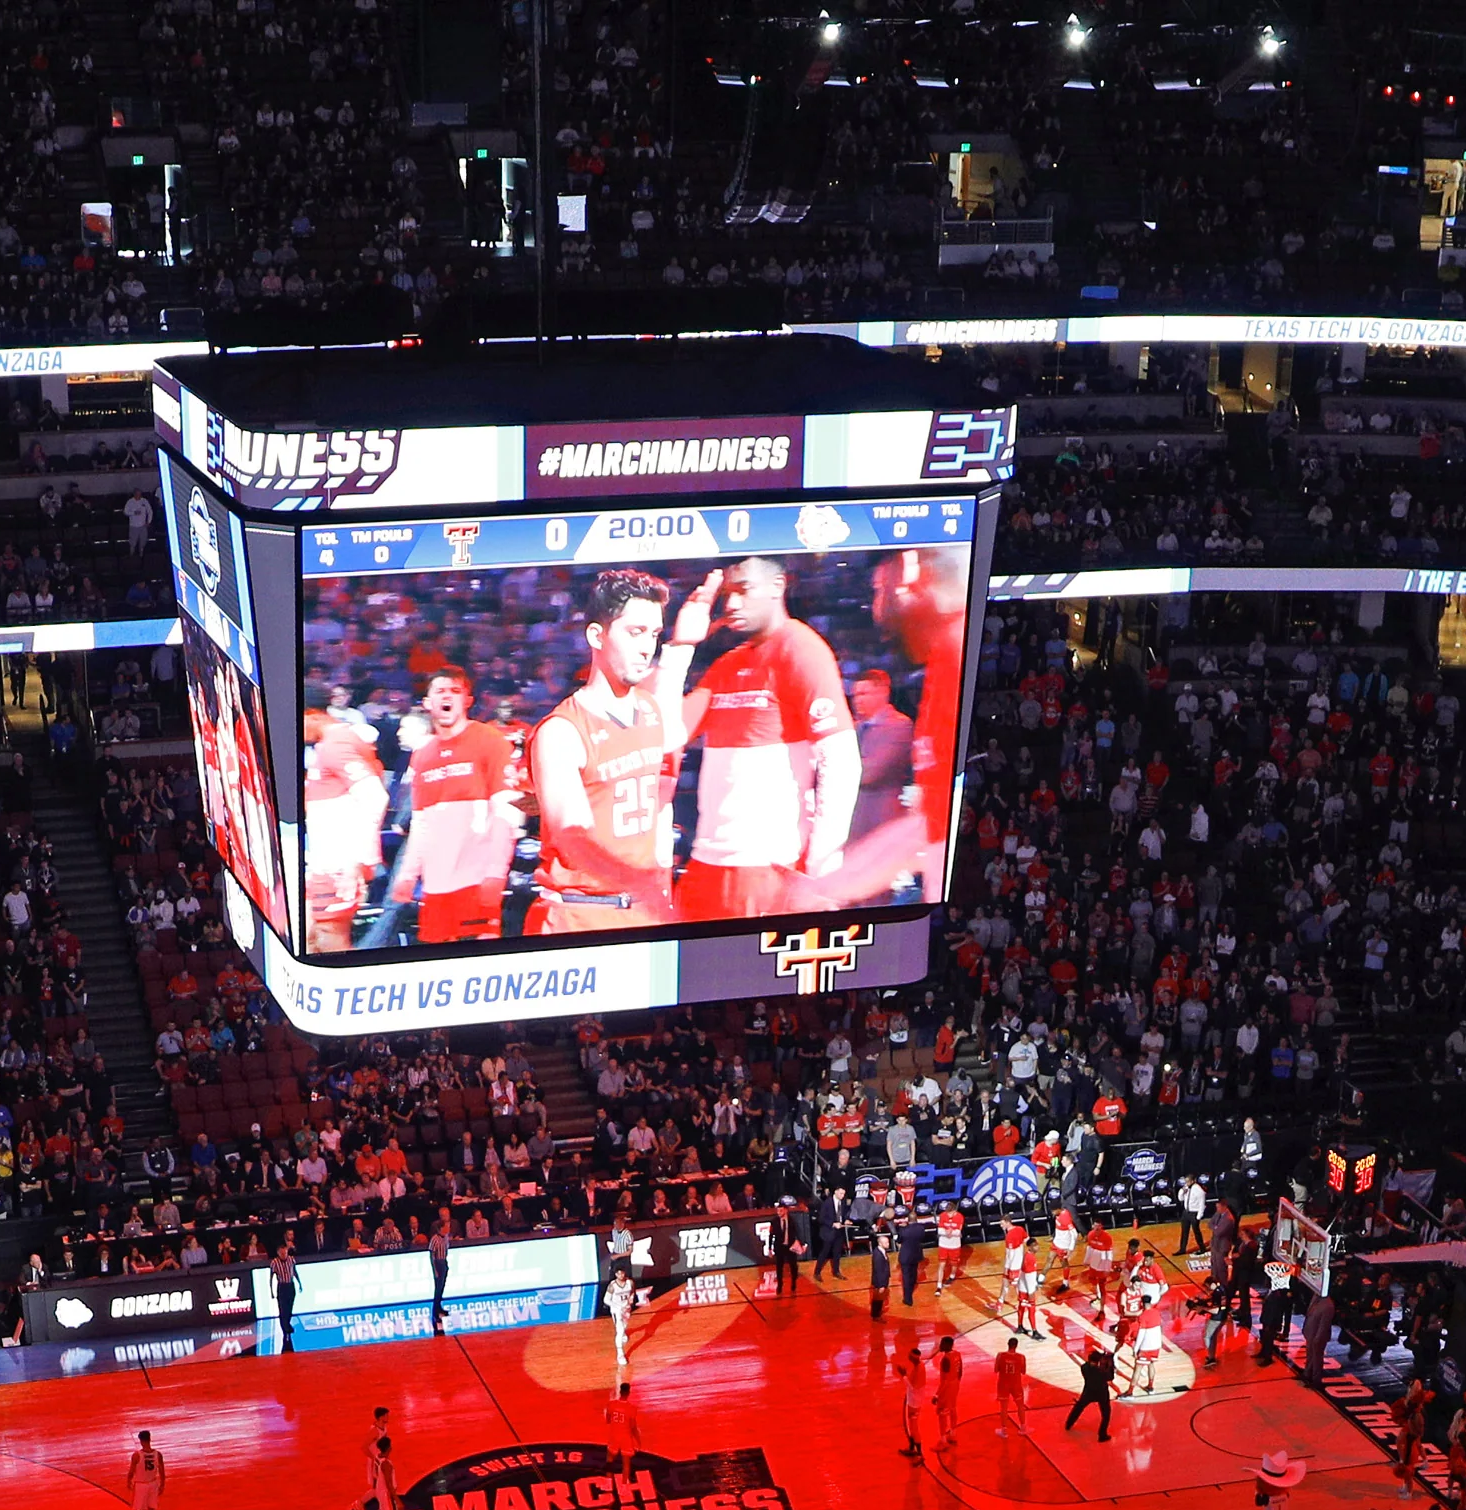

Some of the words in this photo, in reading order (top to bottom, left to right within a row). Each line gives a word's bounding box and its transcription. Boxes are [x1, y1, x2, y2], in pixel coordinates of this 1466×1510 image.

[905, 319, 1057, 345] #MARCHMADNESS
[1244, 320, 1300, 339] TEXAS
[1308, 321, 1352, 339] TECH
[1358, 321, 1382, 340] VS
[538, 436, 791, 478] #MARCHMADNESS
[872, 507, 891, 519] TM
[351, 530, 372, 543] TM
[373, 528, 413, 542] FOULS
[546, 518, 568, 551] 0
[608, 514, 694, 539] 20:00
[728, 511, 750, 542] 0
[1417, 570, 1455, 593] THE
[612, 772, 658, 838] 25
[334, 982, 407, 1016] TECH
[417, 979, 452, 1009] VS
[463, 966, 598, 1005] GONZAGA
[1132, 1156, 1154, 1166] MARCH
[1133, 1162, 1166, 1173] MADNESS
[1355, 1153, 1376, 1173] 20:00
[678, 1225, 731, 1250] TEXAS
[685, 1244, 727, 1268] TECH
[110, 1290, 193, 1318] GONZAGA
[612, 1411, 625, 1424] 23
[468, 1451, 543, 1477] SWEET
[554, 1450, 583, 1465] 16
